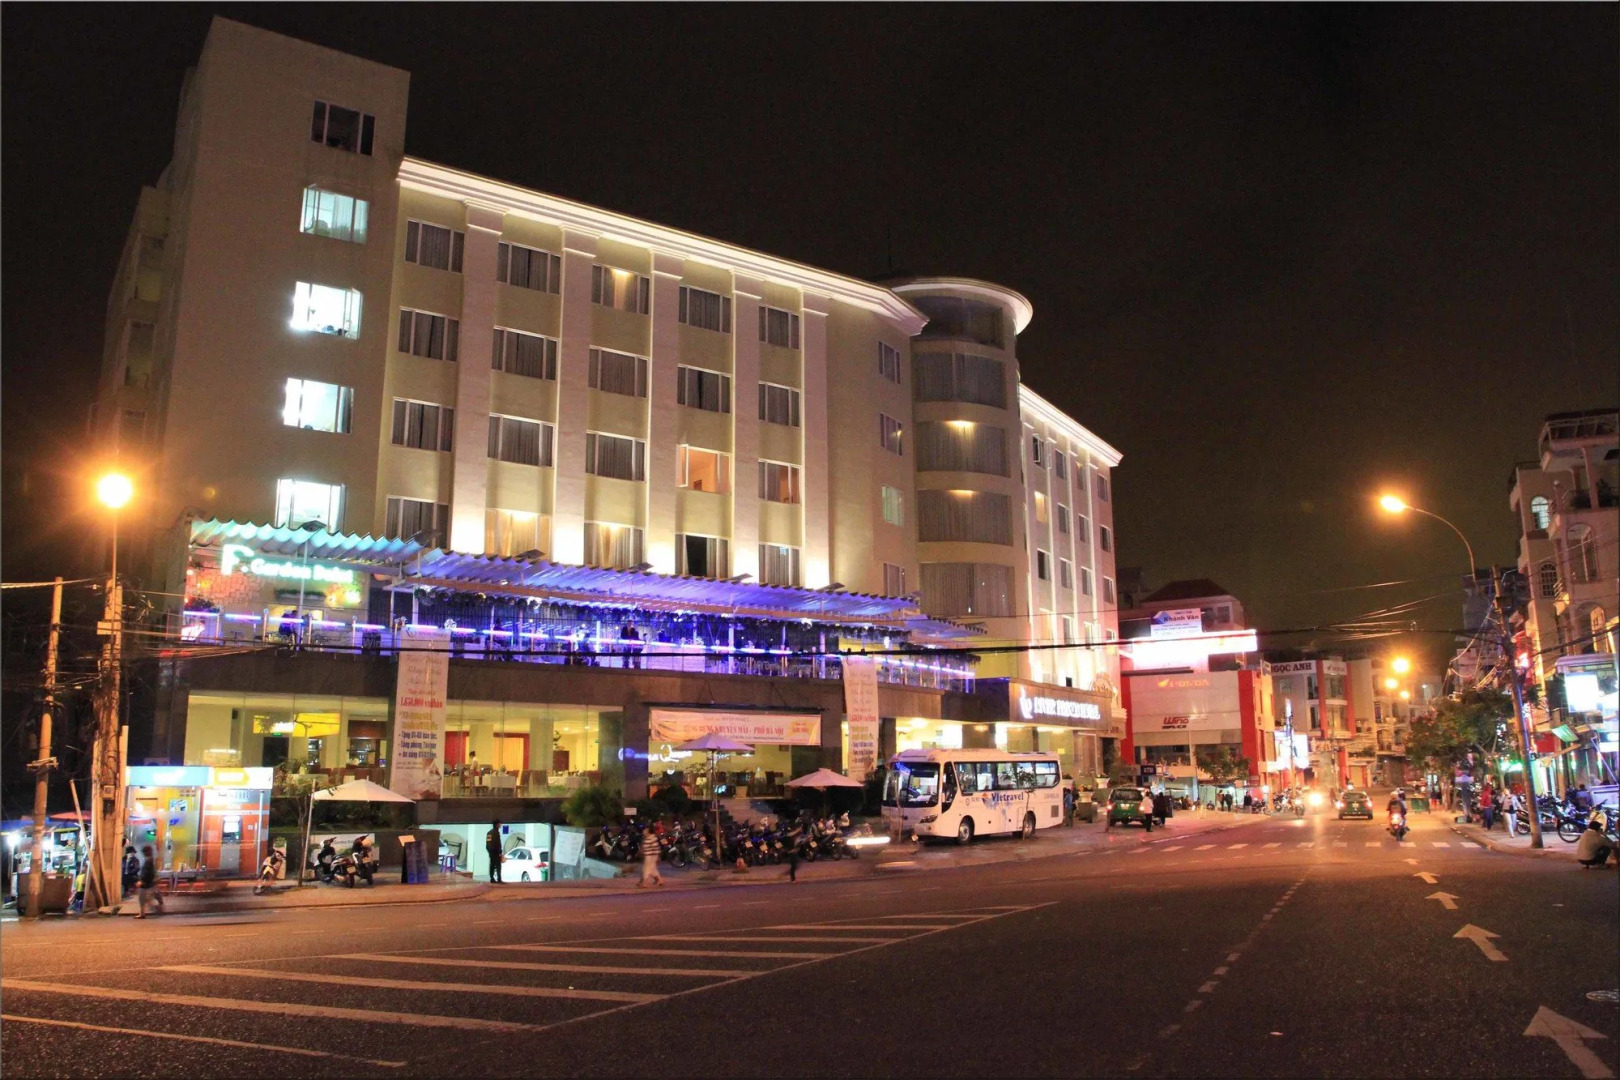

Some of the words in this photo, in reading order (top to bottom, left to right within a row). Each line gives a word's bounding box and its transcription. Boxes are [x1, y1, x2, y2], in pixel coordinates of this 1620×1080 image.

[1271, 664, 1291, 673] GỌC
[1293, 662, 1312, 671] ANH
[991, 791, 1024, 802] Vietravel
